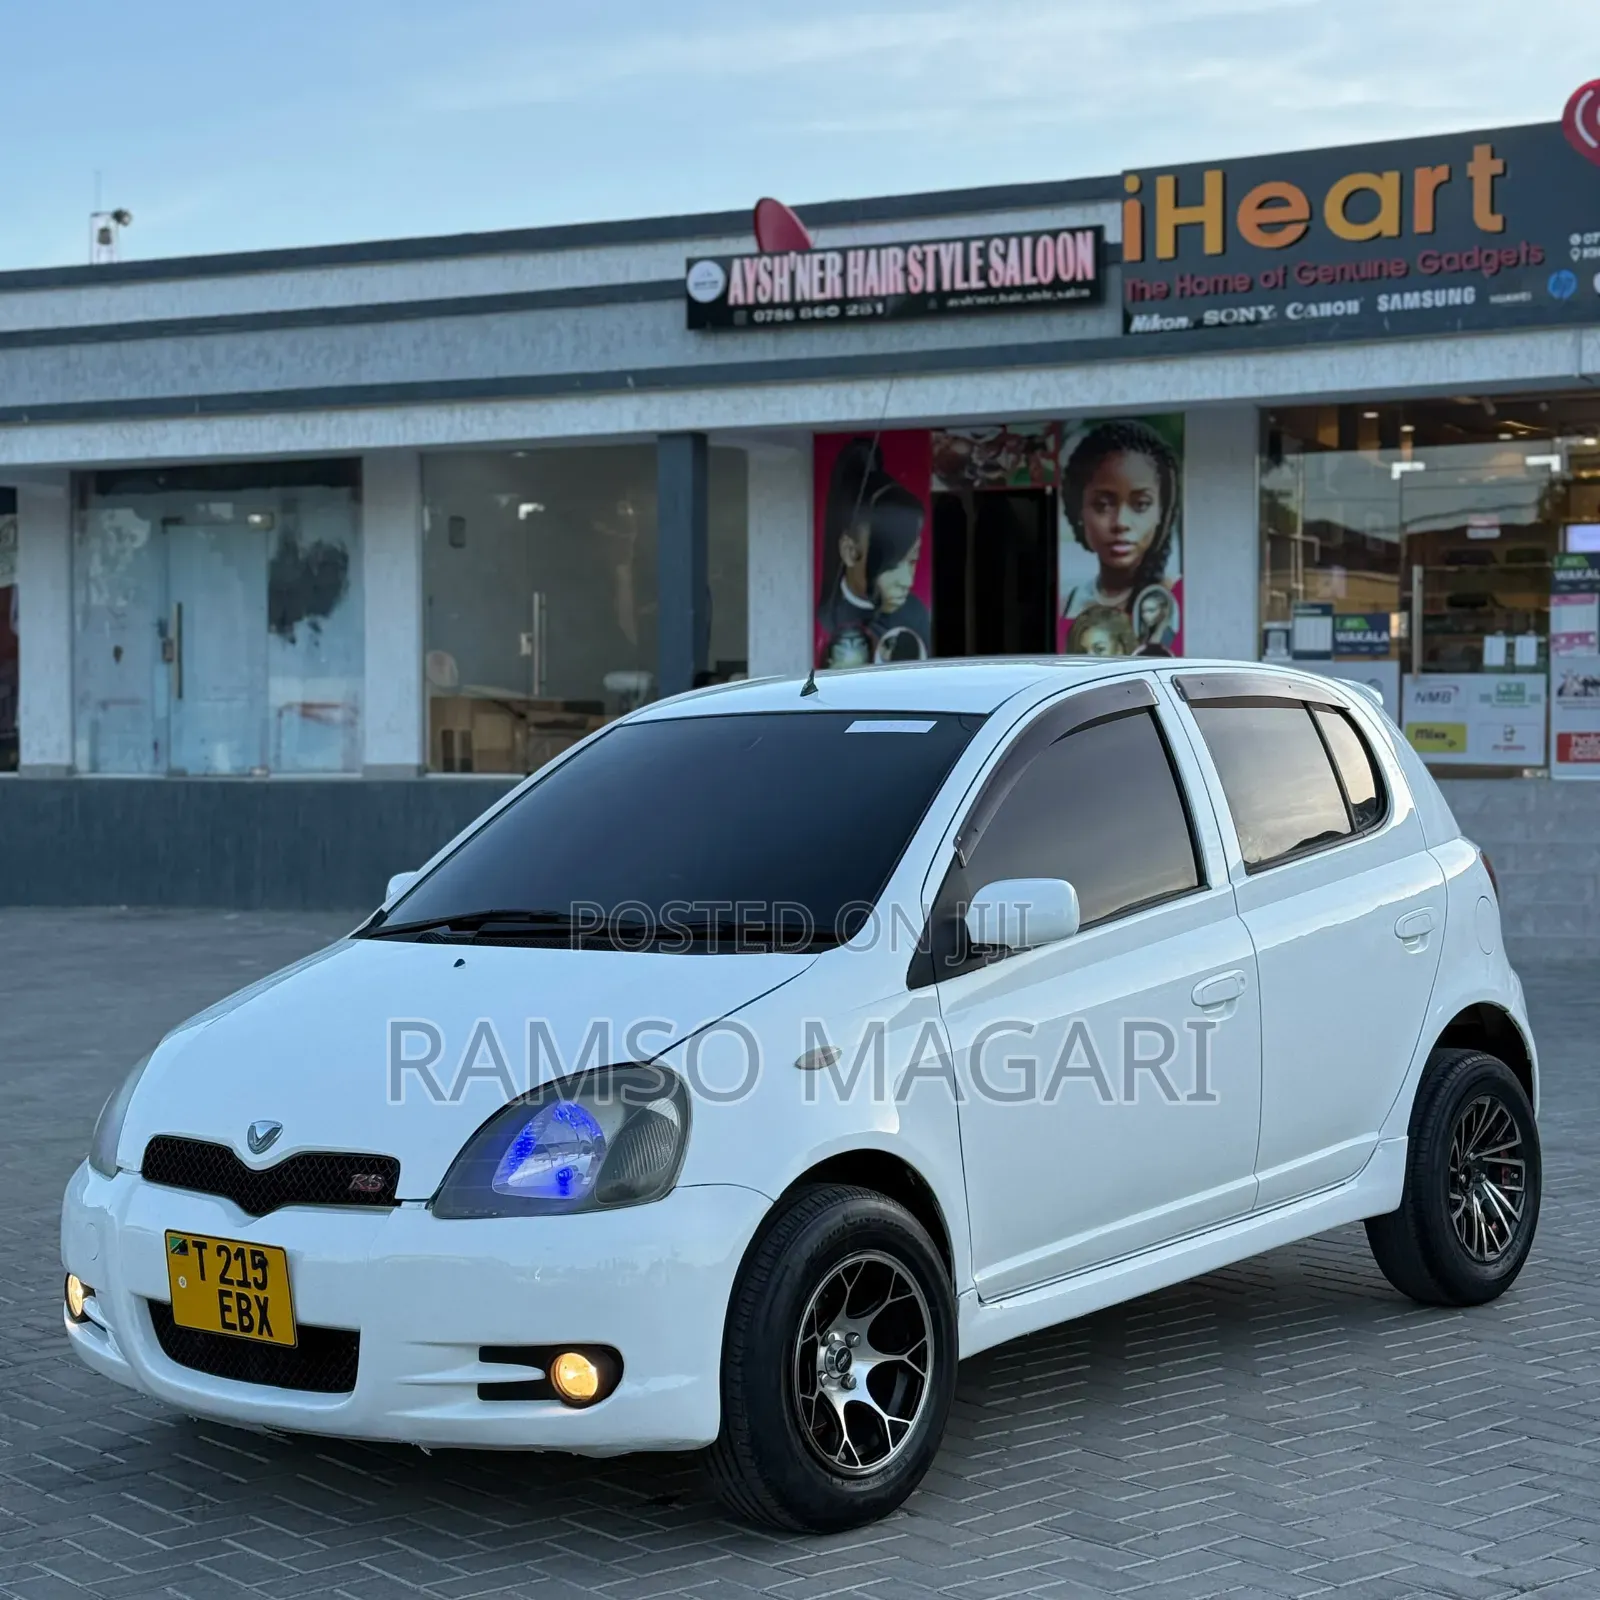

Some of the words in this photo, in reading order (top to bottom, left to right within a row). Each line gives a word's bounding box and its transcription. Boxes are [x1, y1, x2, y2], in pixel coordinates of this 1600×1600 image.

[1122, 144, 1506, 262] iHeart
[728, 251, 843, 306] AYSH'NER
[988, 230, 1096, 289] SALOON
[1124, 277, 1169, 302] The
[1175, 271, 1252, 297] Home
[1259, 265, 1287, 289] of
[1293, 254, 1409, 287] Genuine
[1416, 240, 1545, 278] Gadgets
[1129, 313, 1190, 333] Nikon
[1203, 305, 1275, 326] SONY
[1285, 299, 1361, 321] Canon
[1377, 286, 1476, 312] SAMSUNG
[1335, 631, 1390, 643] WAKALA
[191, 1239, 208, 1283] T
[216, 1243, 269, 1292] 215
[218, 1288, 274, 1339] EBX
